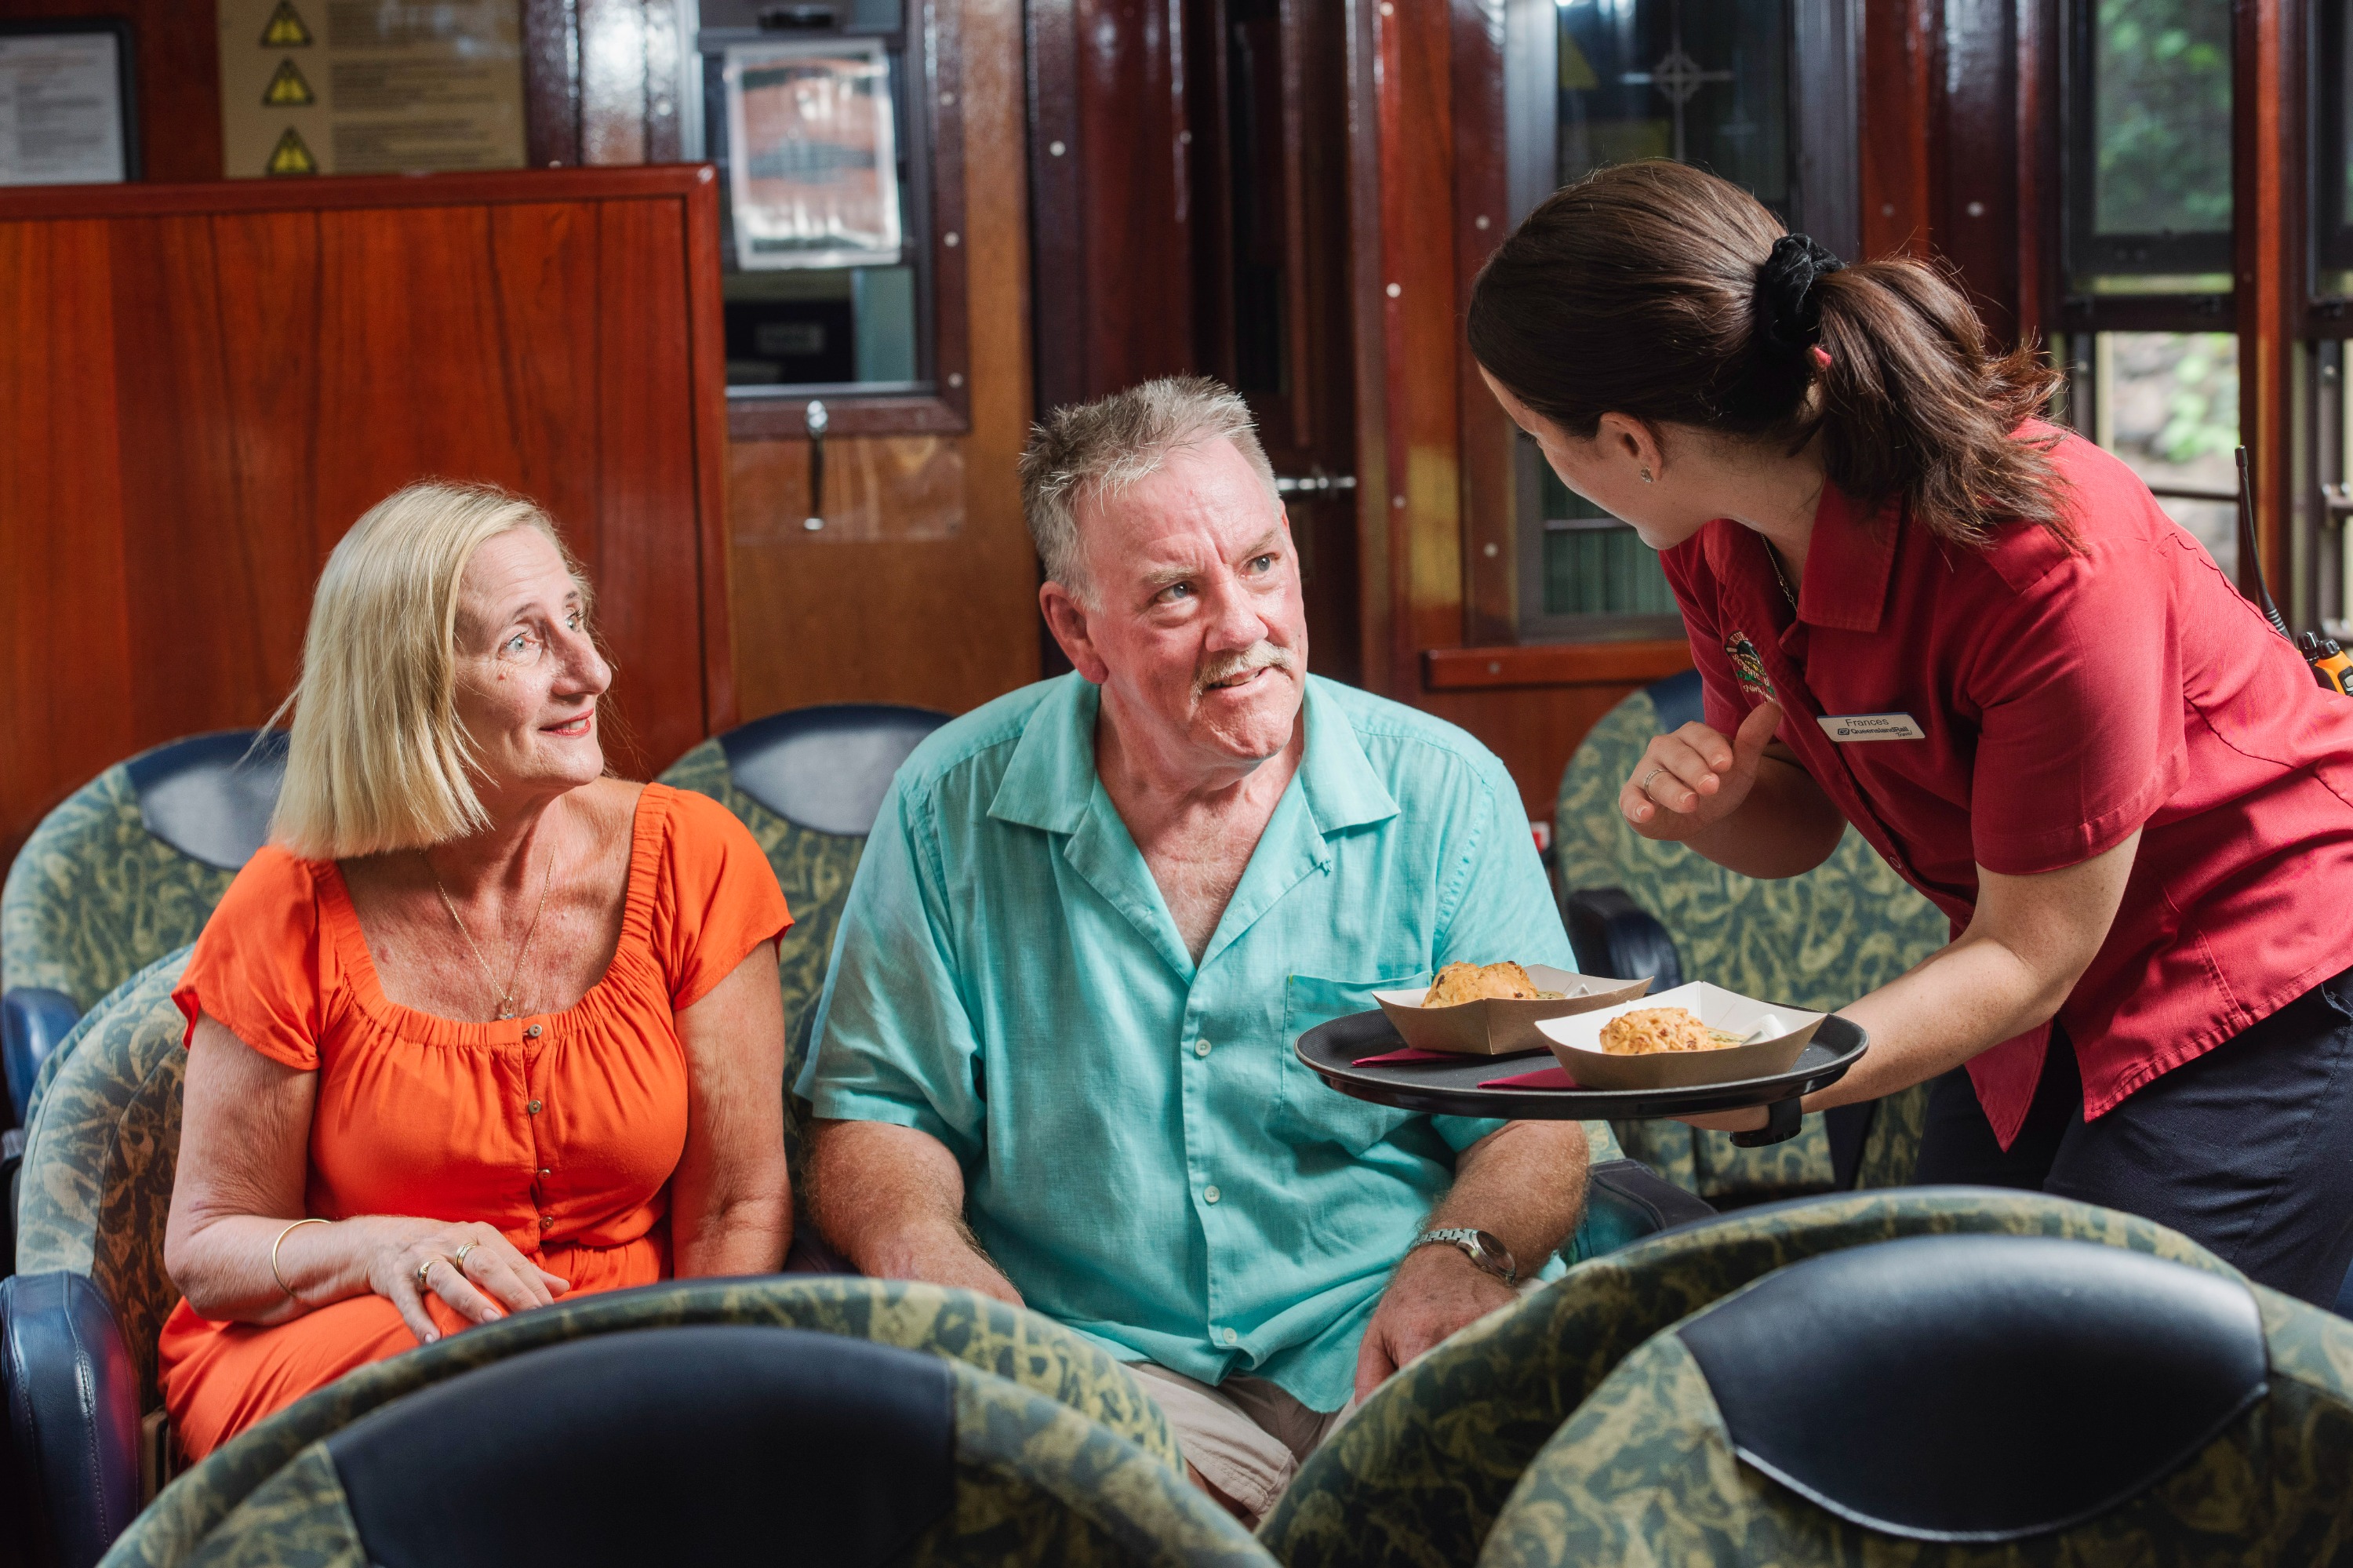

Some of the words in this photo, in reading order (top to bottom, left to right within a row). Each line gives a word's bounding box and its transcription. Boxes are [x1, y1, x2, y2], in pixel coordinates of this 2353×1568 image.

[1732, 653, 1761, 681] SCENIC
[1845, 718, 1889, 726] Frances
[1895, 729, 1913, 738] Travel
